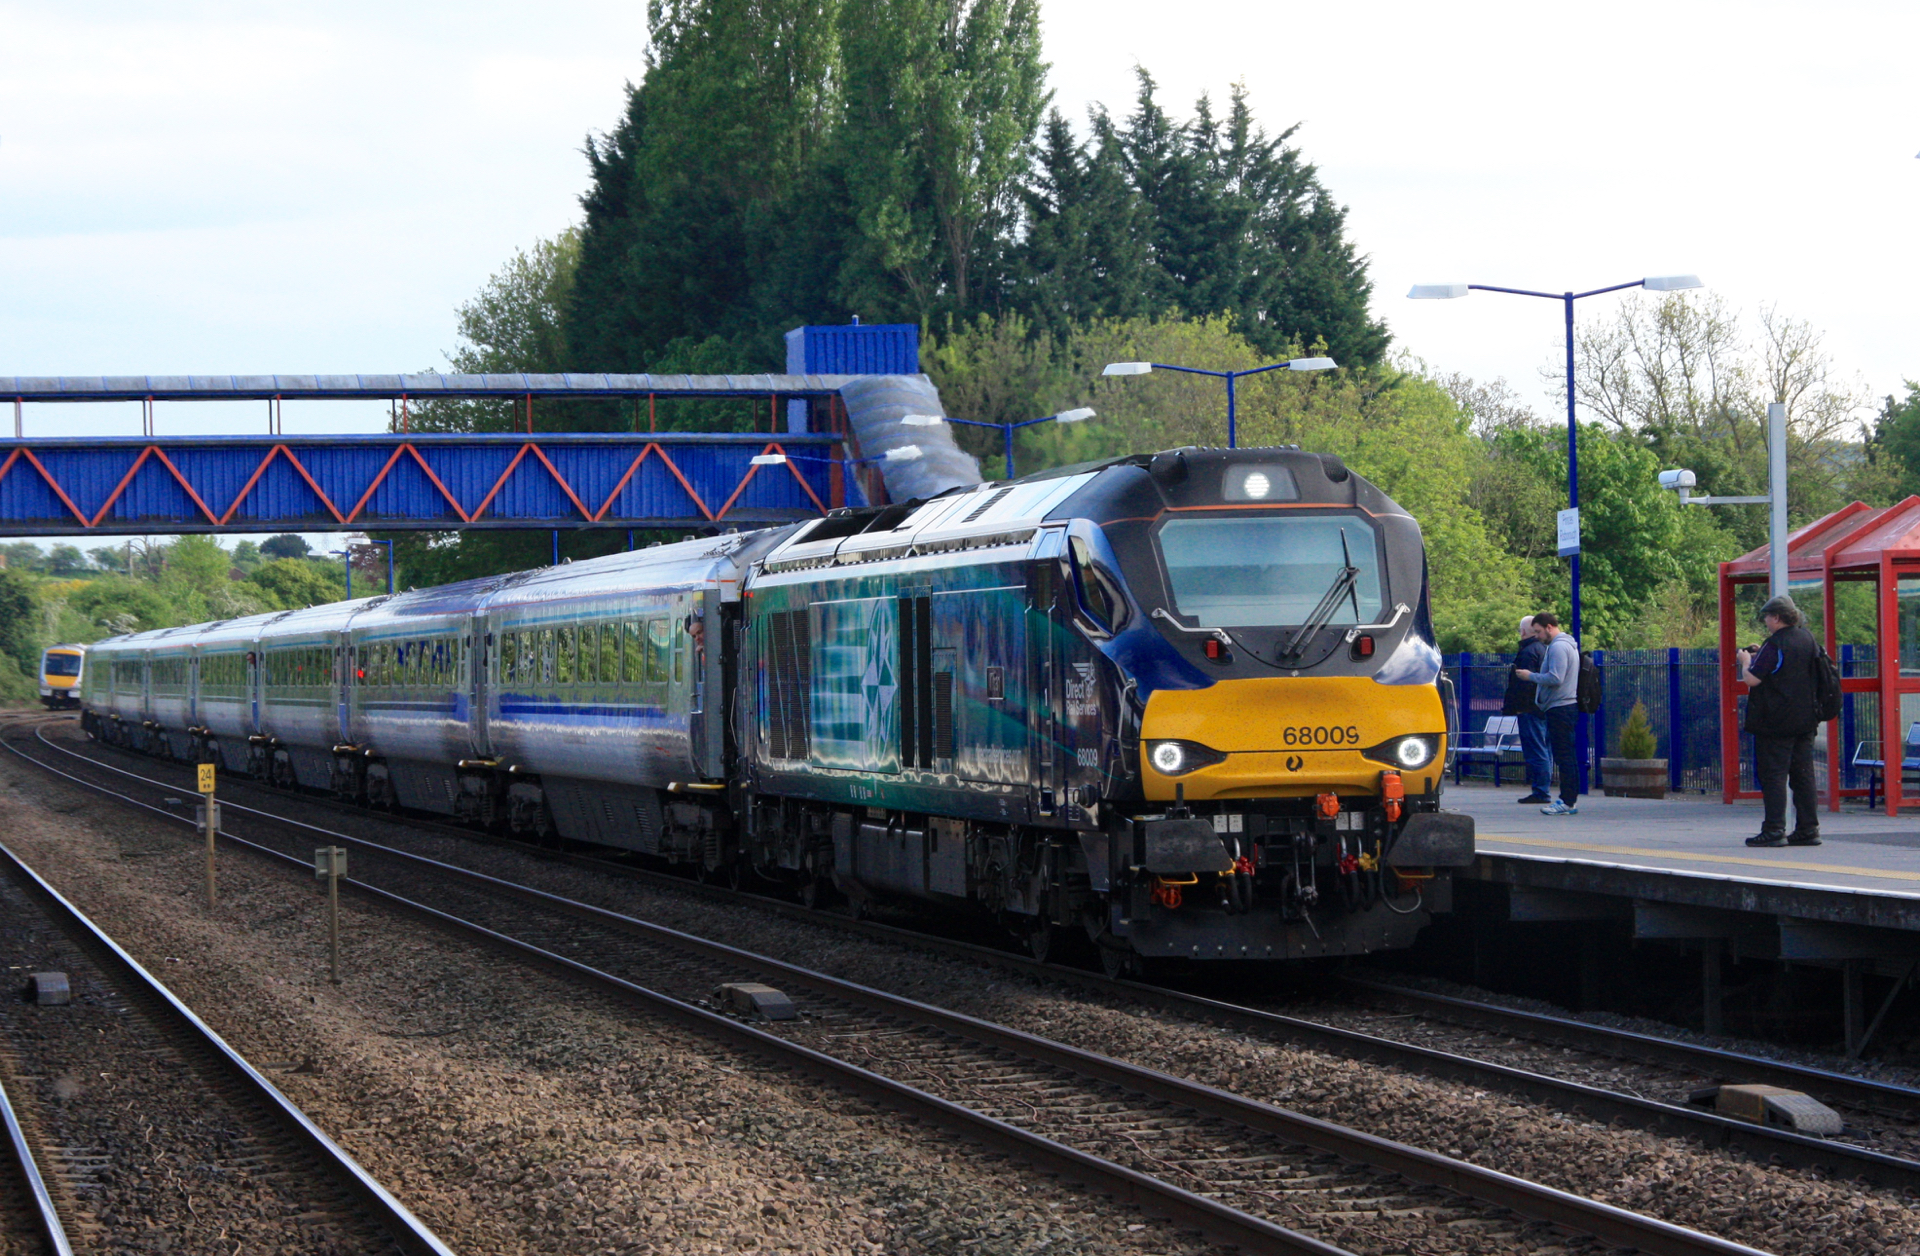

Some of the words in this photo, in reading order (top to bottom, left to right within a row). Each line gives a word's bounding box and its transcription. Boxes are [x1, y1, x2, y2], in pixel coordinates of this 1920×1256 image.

[1066, 679, 1085, 699] Direct
[1066, 700, 1076, 716] Rail
[1076, 700, 1097, 716] Services
[1283, 725, 1360, 746] 68009
[1077, 748, 1098, 767] 68009
[200, 768, 213, 782] 24
